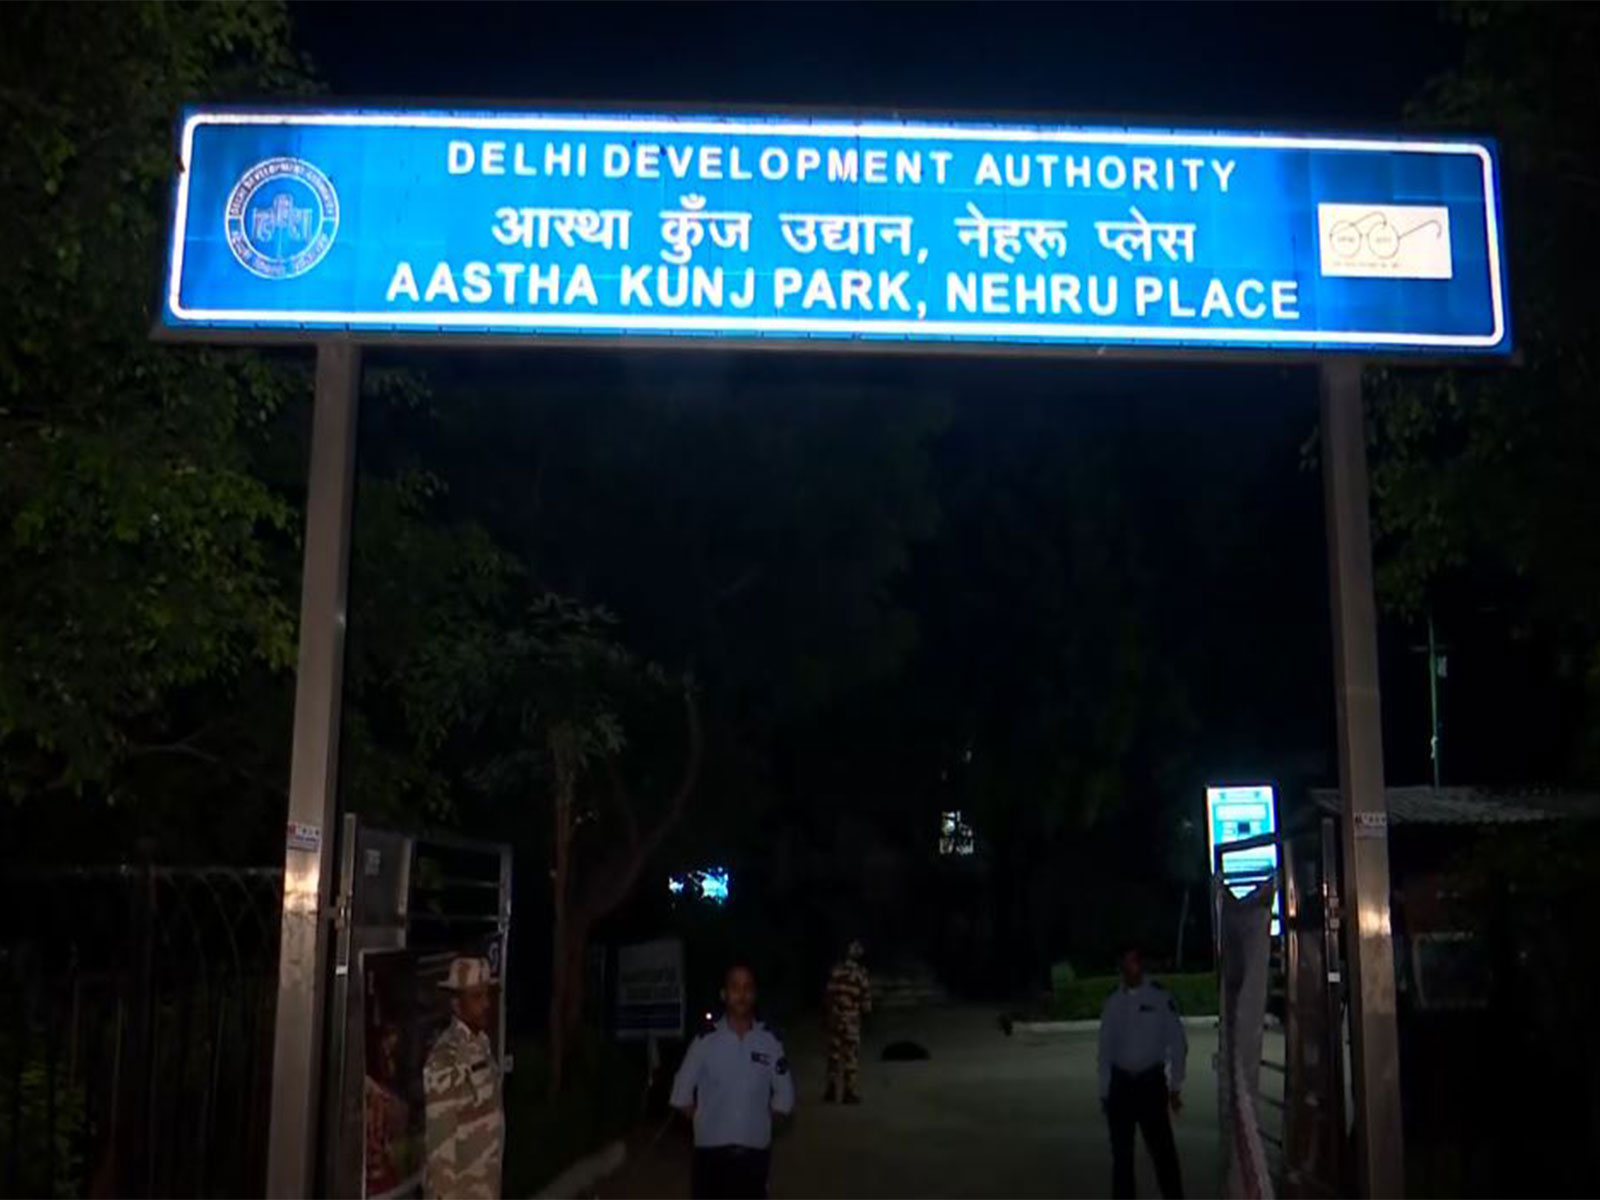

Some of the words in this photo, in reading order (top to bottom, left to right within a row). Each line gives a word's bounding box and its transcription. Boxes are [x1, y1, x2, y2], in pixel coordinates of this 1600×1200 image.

[448, 141, 586, 175] DELHI
[604, 144, 952, 184] DEVELOPMENT
[976, 154, 1235, 192] AUTHORITY
[491, 207, 632, 249] आस्था
[659, 194, 752, 263] कुँज
[779, 213, 928, 264] उद्यान,
[954, 202, 1067, 263] नेहरू
[1094, 206, 1196, 263] प्लेस
[387, 262, 598, 305] AASTHA
[620, 265, 755, 307] KUNJ
[773, 269, 927, 319] PARK,
[947, 273, 1117, 316] NEHRU
[1136, 277, 1299, 319] PLACE
